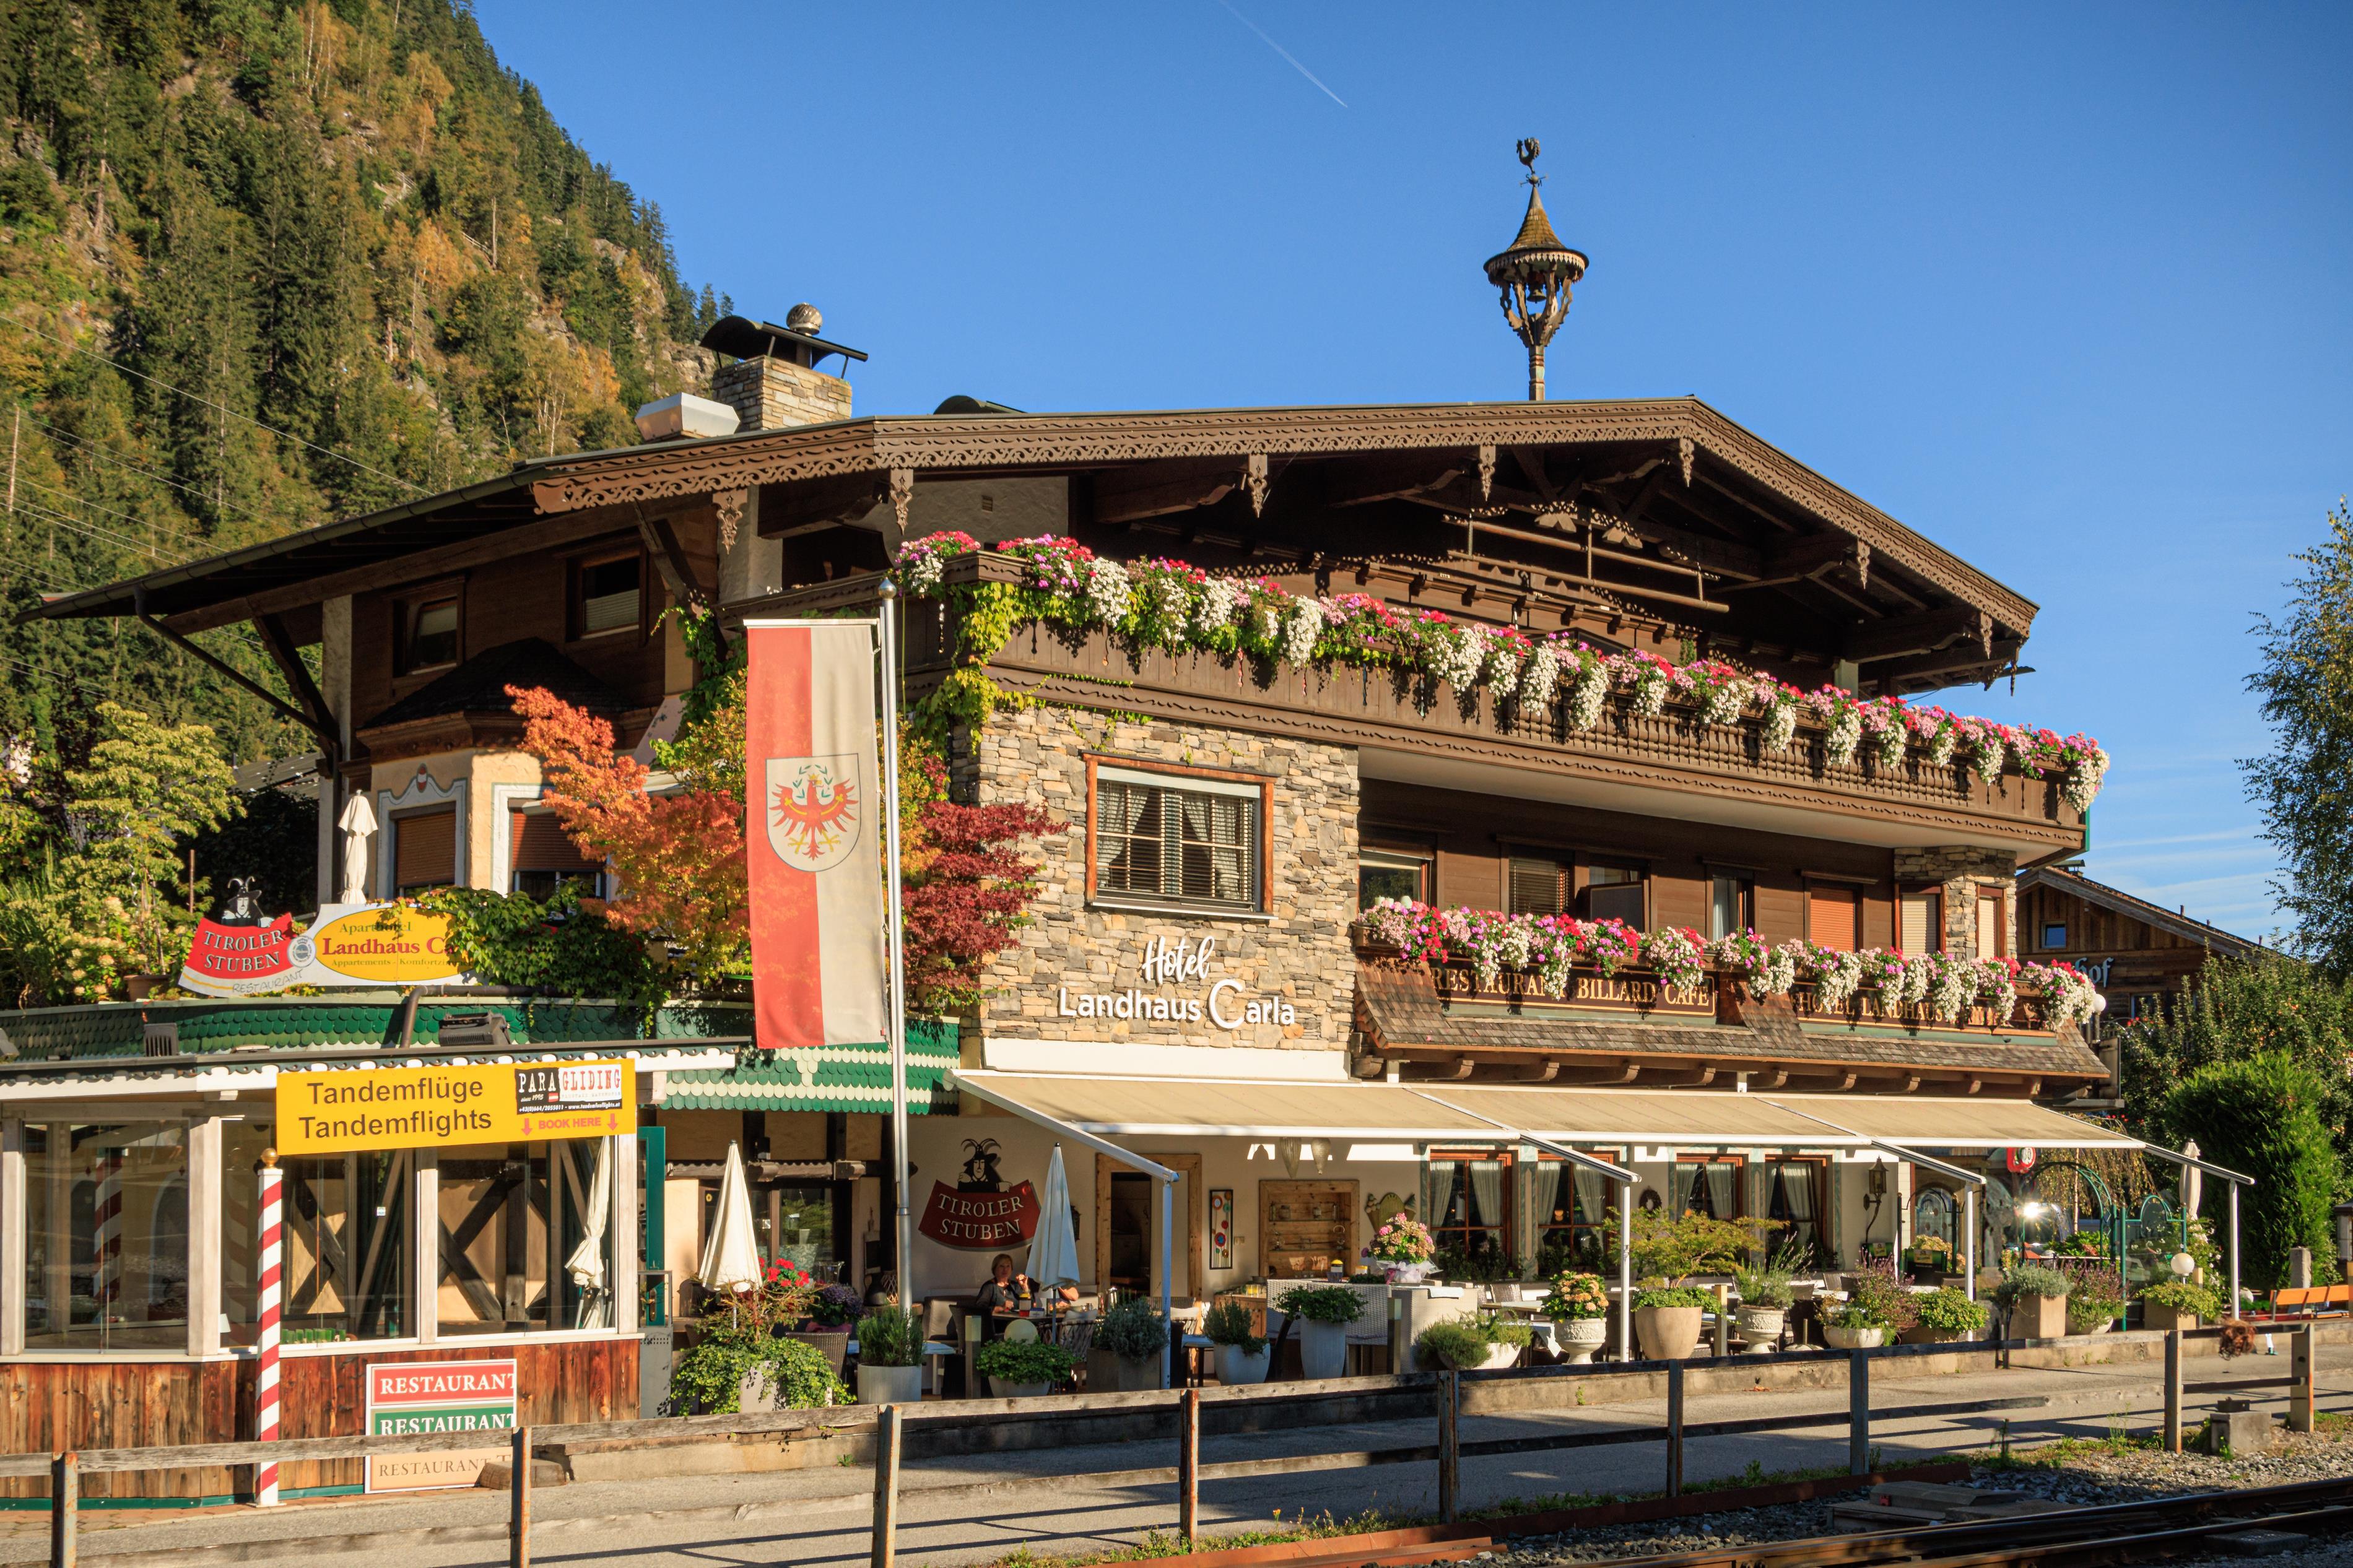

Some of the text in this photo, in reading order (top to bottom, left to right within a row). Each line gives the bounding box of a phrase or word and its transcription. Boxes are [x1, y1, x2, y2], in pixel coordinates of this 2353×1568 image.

[204, 930, 285, 951] TIROLER
[322, 937, 420, 955] Landhaus
[204, 951, 279, 972] STUBEN
[331, 958, 391, 968] Appartements
[1142, 935, 1215, 985] Hotel
[232, 968, 304, 994] RESTAURANT
[1577, 977, 1656, 1002] BILLARD
[1059, 979, 1295, 1029] Landhaus Carla
[307, 1076, 483, 1104] Tandemflüge
[298, 1109, 492, 1139] Tandemflights
[539, 1117, 601, 1130] BOOK HERE
[937, 1193, 1024, 1218] TIROLER
[940, 1218, 1020, 1240] STUBEN
